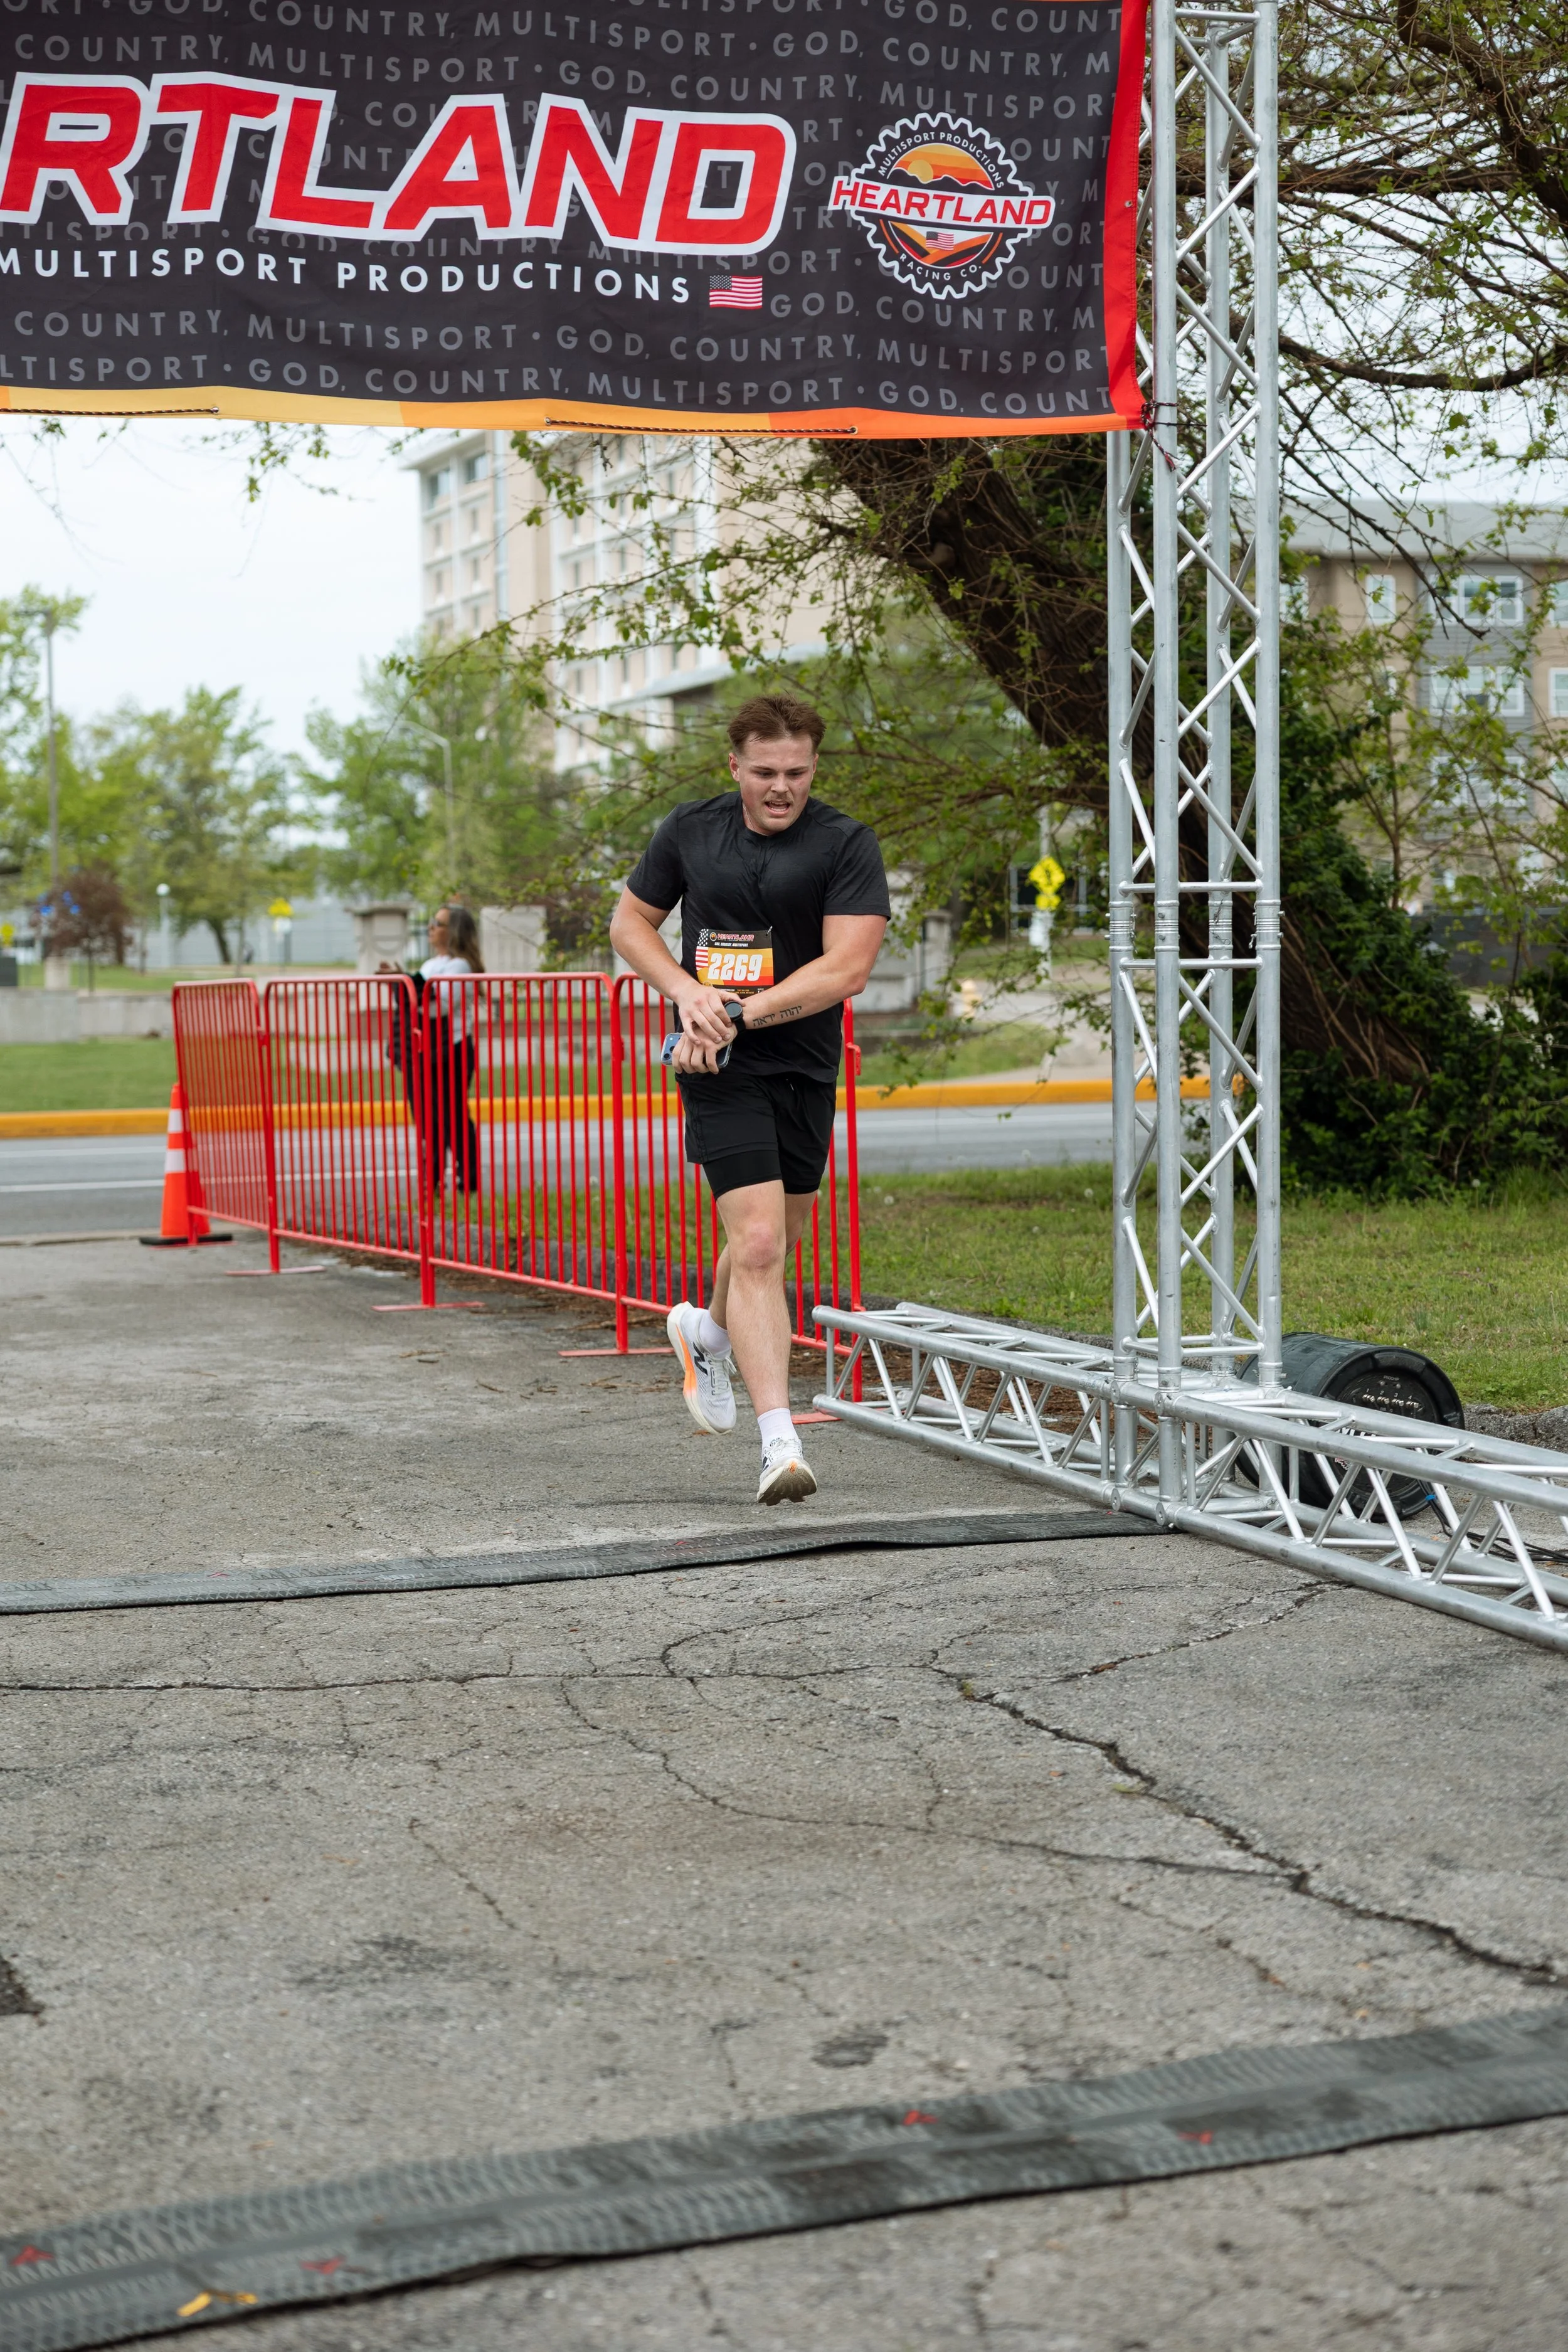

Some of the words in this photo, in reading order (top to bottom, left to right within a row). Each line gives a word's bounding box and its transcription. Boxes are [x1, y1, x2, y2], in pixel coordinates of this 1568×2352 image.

[250, 0, 455, 38] COUNTRY,
[475, 11, 734, 56] MULTISPORT
[773, 30, 863, 58] GOD,
[882, 38, 1067, 77] COUNTRY,
[885, 0, 972, 29] GOD,
[991, 8, 1121, 33] COUNT
[15, 34, 228, 63] COUNTRY,
[248, 42, 519, 82] MULTISPORT
[559, 60, 651, 97] GOD,
[671, 74, 862, 102] COUNTRY,
[0, 72, 797, 255] RTLAND
[879, 132, 936, 177] MULTISPORT
[940, 132, 1004, 188] PRODUCTIONS
[832, 179, 1052, 226] HEARTLAND
[0, 247, 306, 283] MULTISPORT
[337, 261, 689, 303] PRODUCTIONS
[900, 253, 951, 281] RACING
[960, 265, 982, 278] CO.
[15, 310, 228, 337] COUNTRY,
[248, 315, 516, 350] MULTISPORT
[557, 325, 650, 359] GOD,
[670, 334, 861, 362] COUNTRY,
[771, 291, 859, 317] GOD,
[876, 296, 1057, 332] COUNTRY,
[249, 358, 346, 391] GOD,
[366, 368, 569, 395] COUNTRY,
[588, 373, 842, 406] MULTISPORT
[879, 381, 965, 413] GOD,
[707, 953, 763, 982] 2269
